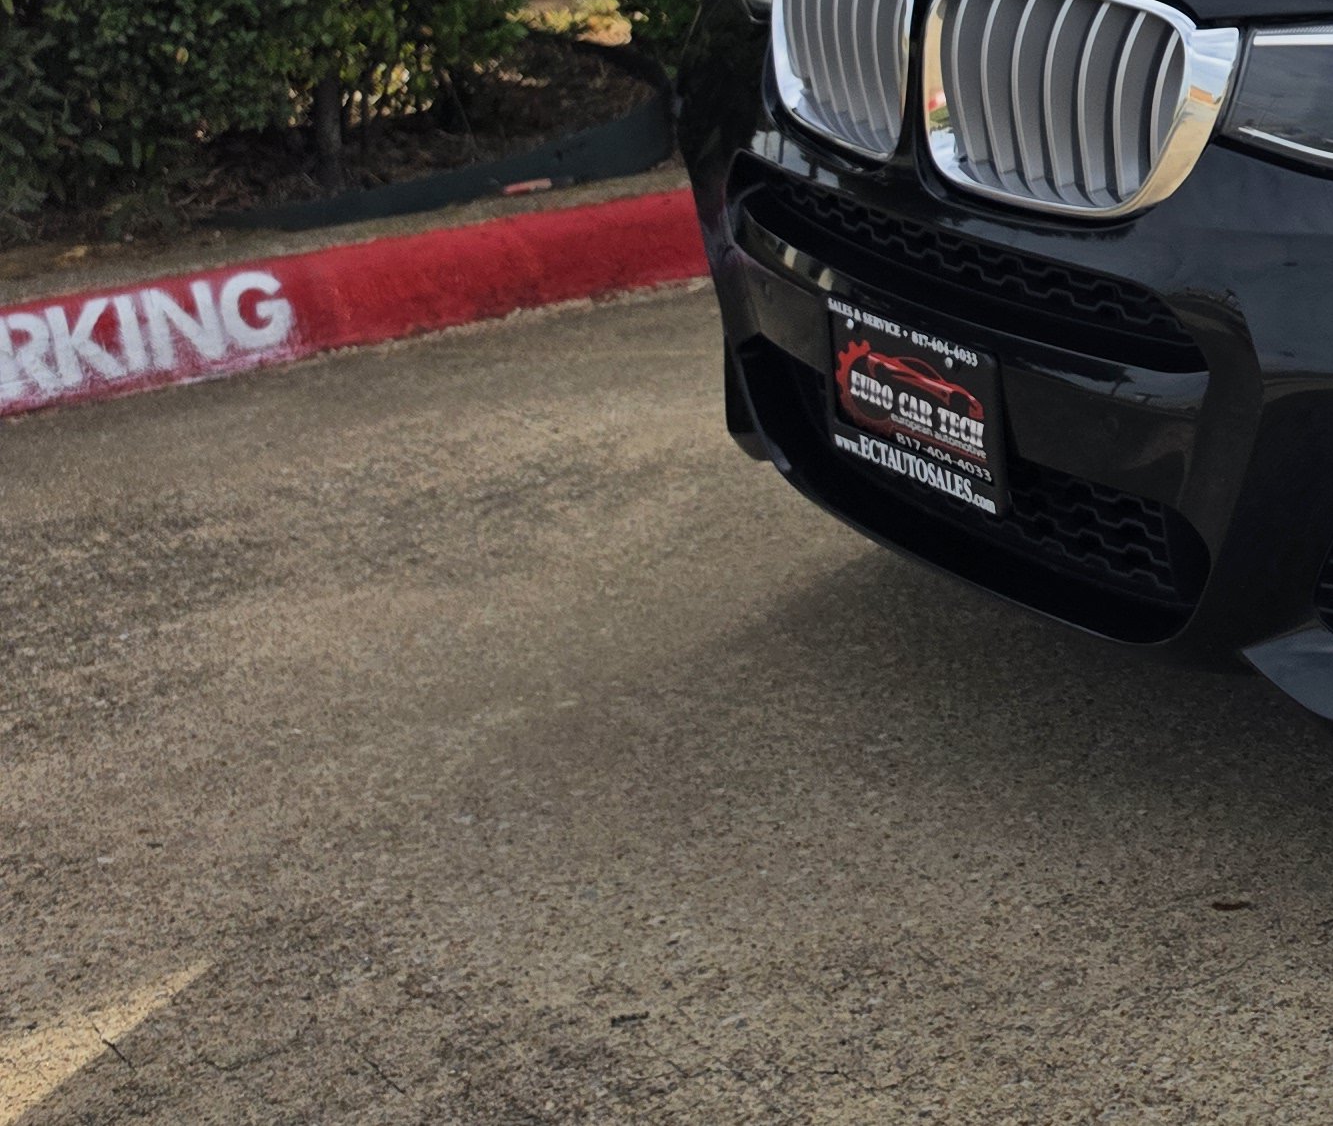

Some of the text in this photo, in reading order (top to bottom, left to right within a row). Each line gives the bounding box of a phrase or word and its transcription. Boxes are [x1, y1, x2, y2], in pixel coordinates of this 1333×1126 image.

[827, 297, 979, 368] SALES & SERVICE 817-404-4033
[850, 369, 985, 449] EURO CAR TECH
[833, 433, 997, 515] www.ECTAUTOSALES.com
[895, 432, 993, 483] 817-404-4033
